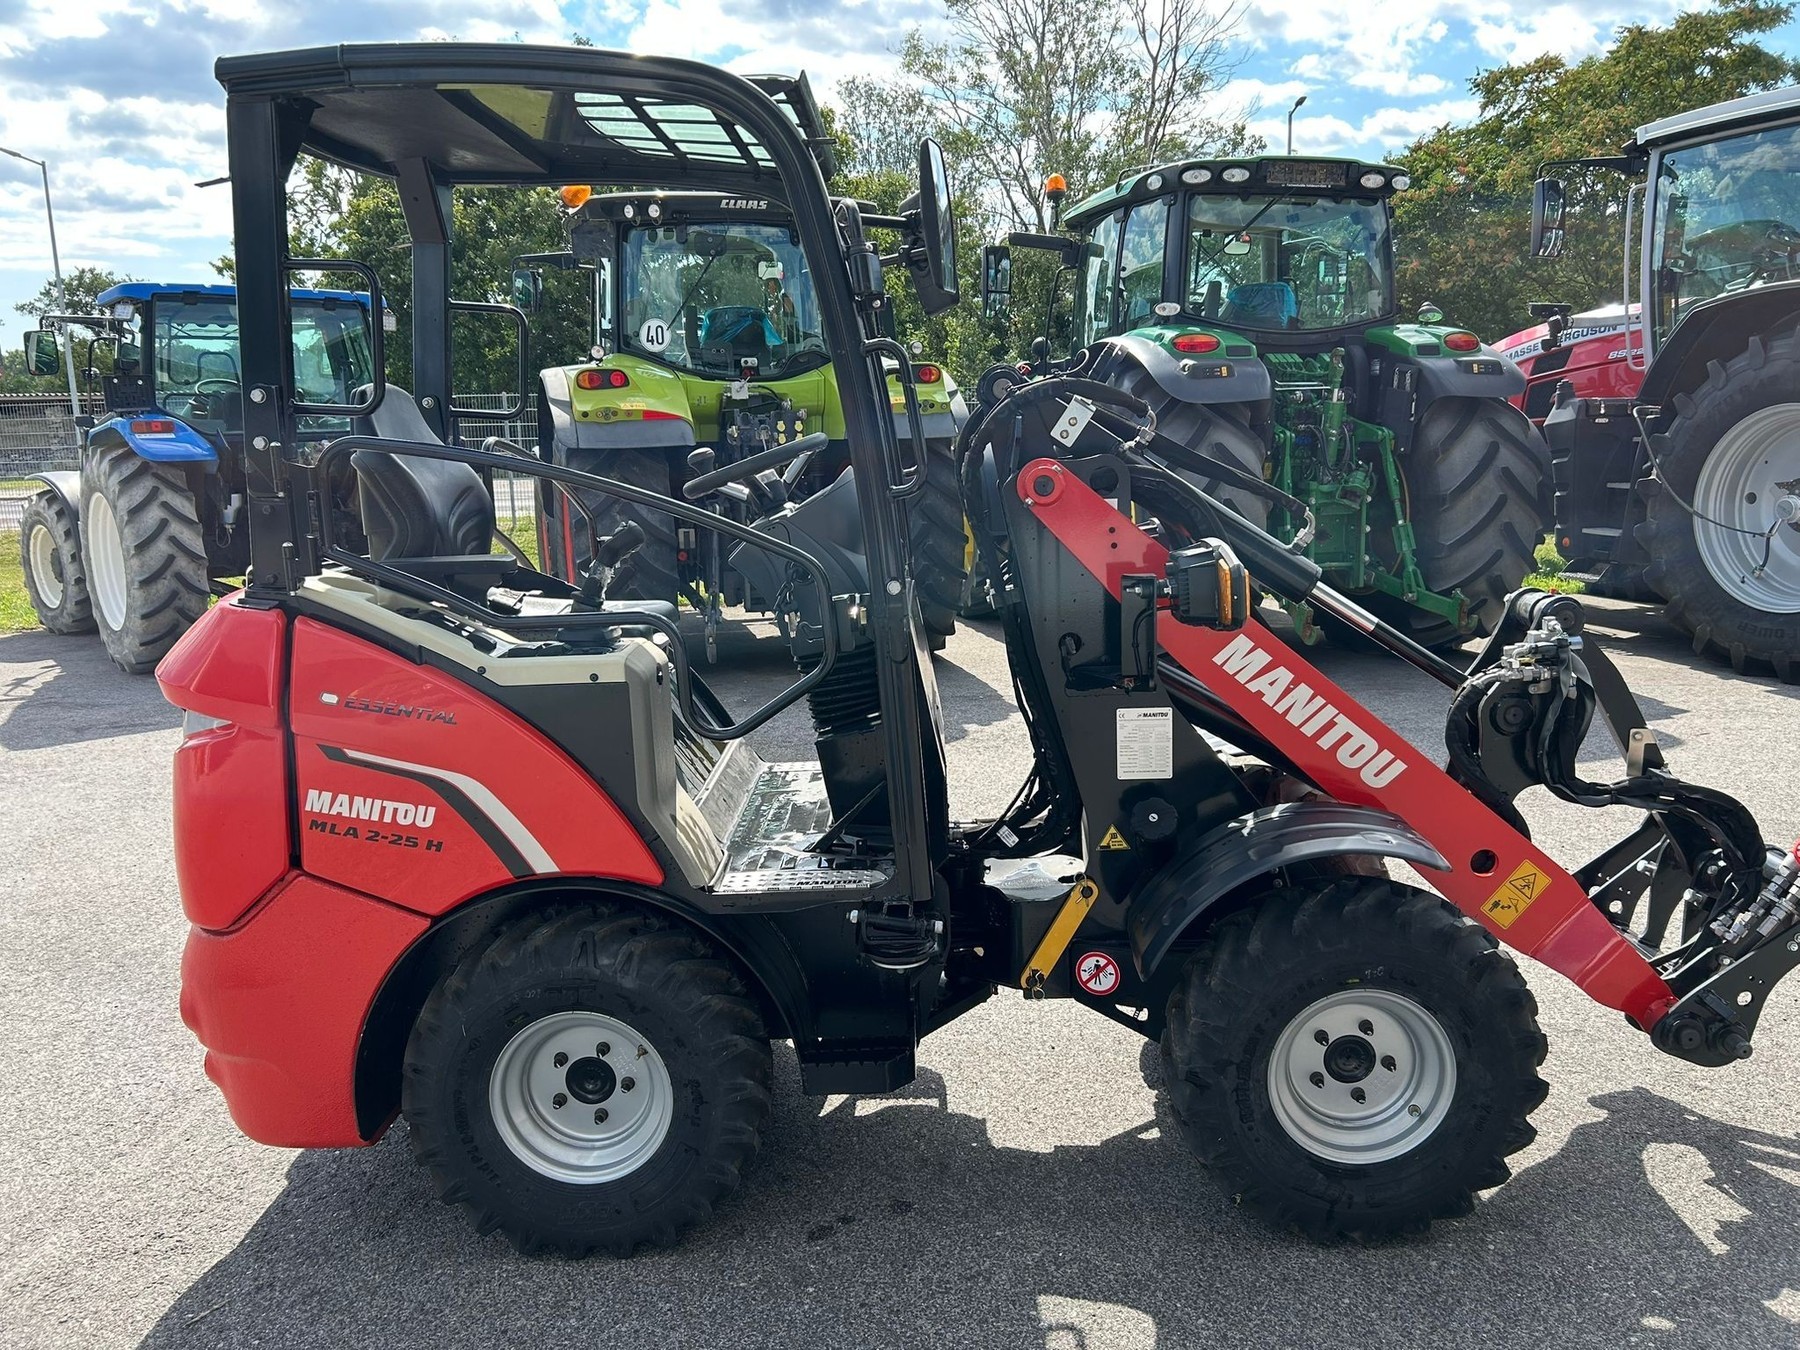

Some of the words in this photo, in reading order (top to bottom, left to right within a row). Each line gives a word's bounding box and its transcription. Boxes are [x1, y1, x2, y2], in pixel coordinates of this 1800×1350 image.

[720, 199, 768, 210] CLAAS
[646, 325, 665, 345] 40
[1505, 342, 1540, 361] MASSE
[1557, 325, 1618, 343] ERGUSON
[344, 695, 458, 726] ESSENTIAL
[1211, 633, 1408, 788] MANITOU
[304, 788, 437, 829] MANITOU
[308, 819, 360, 840] MLA
[365, 829, 420, 849] 2-25
[425, 839, 444, 853] H
